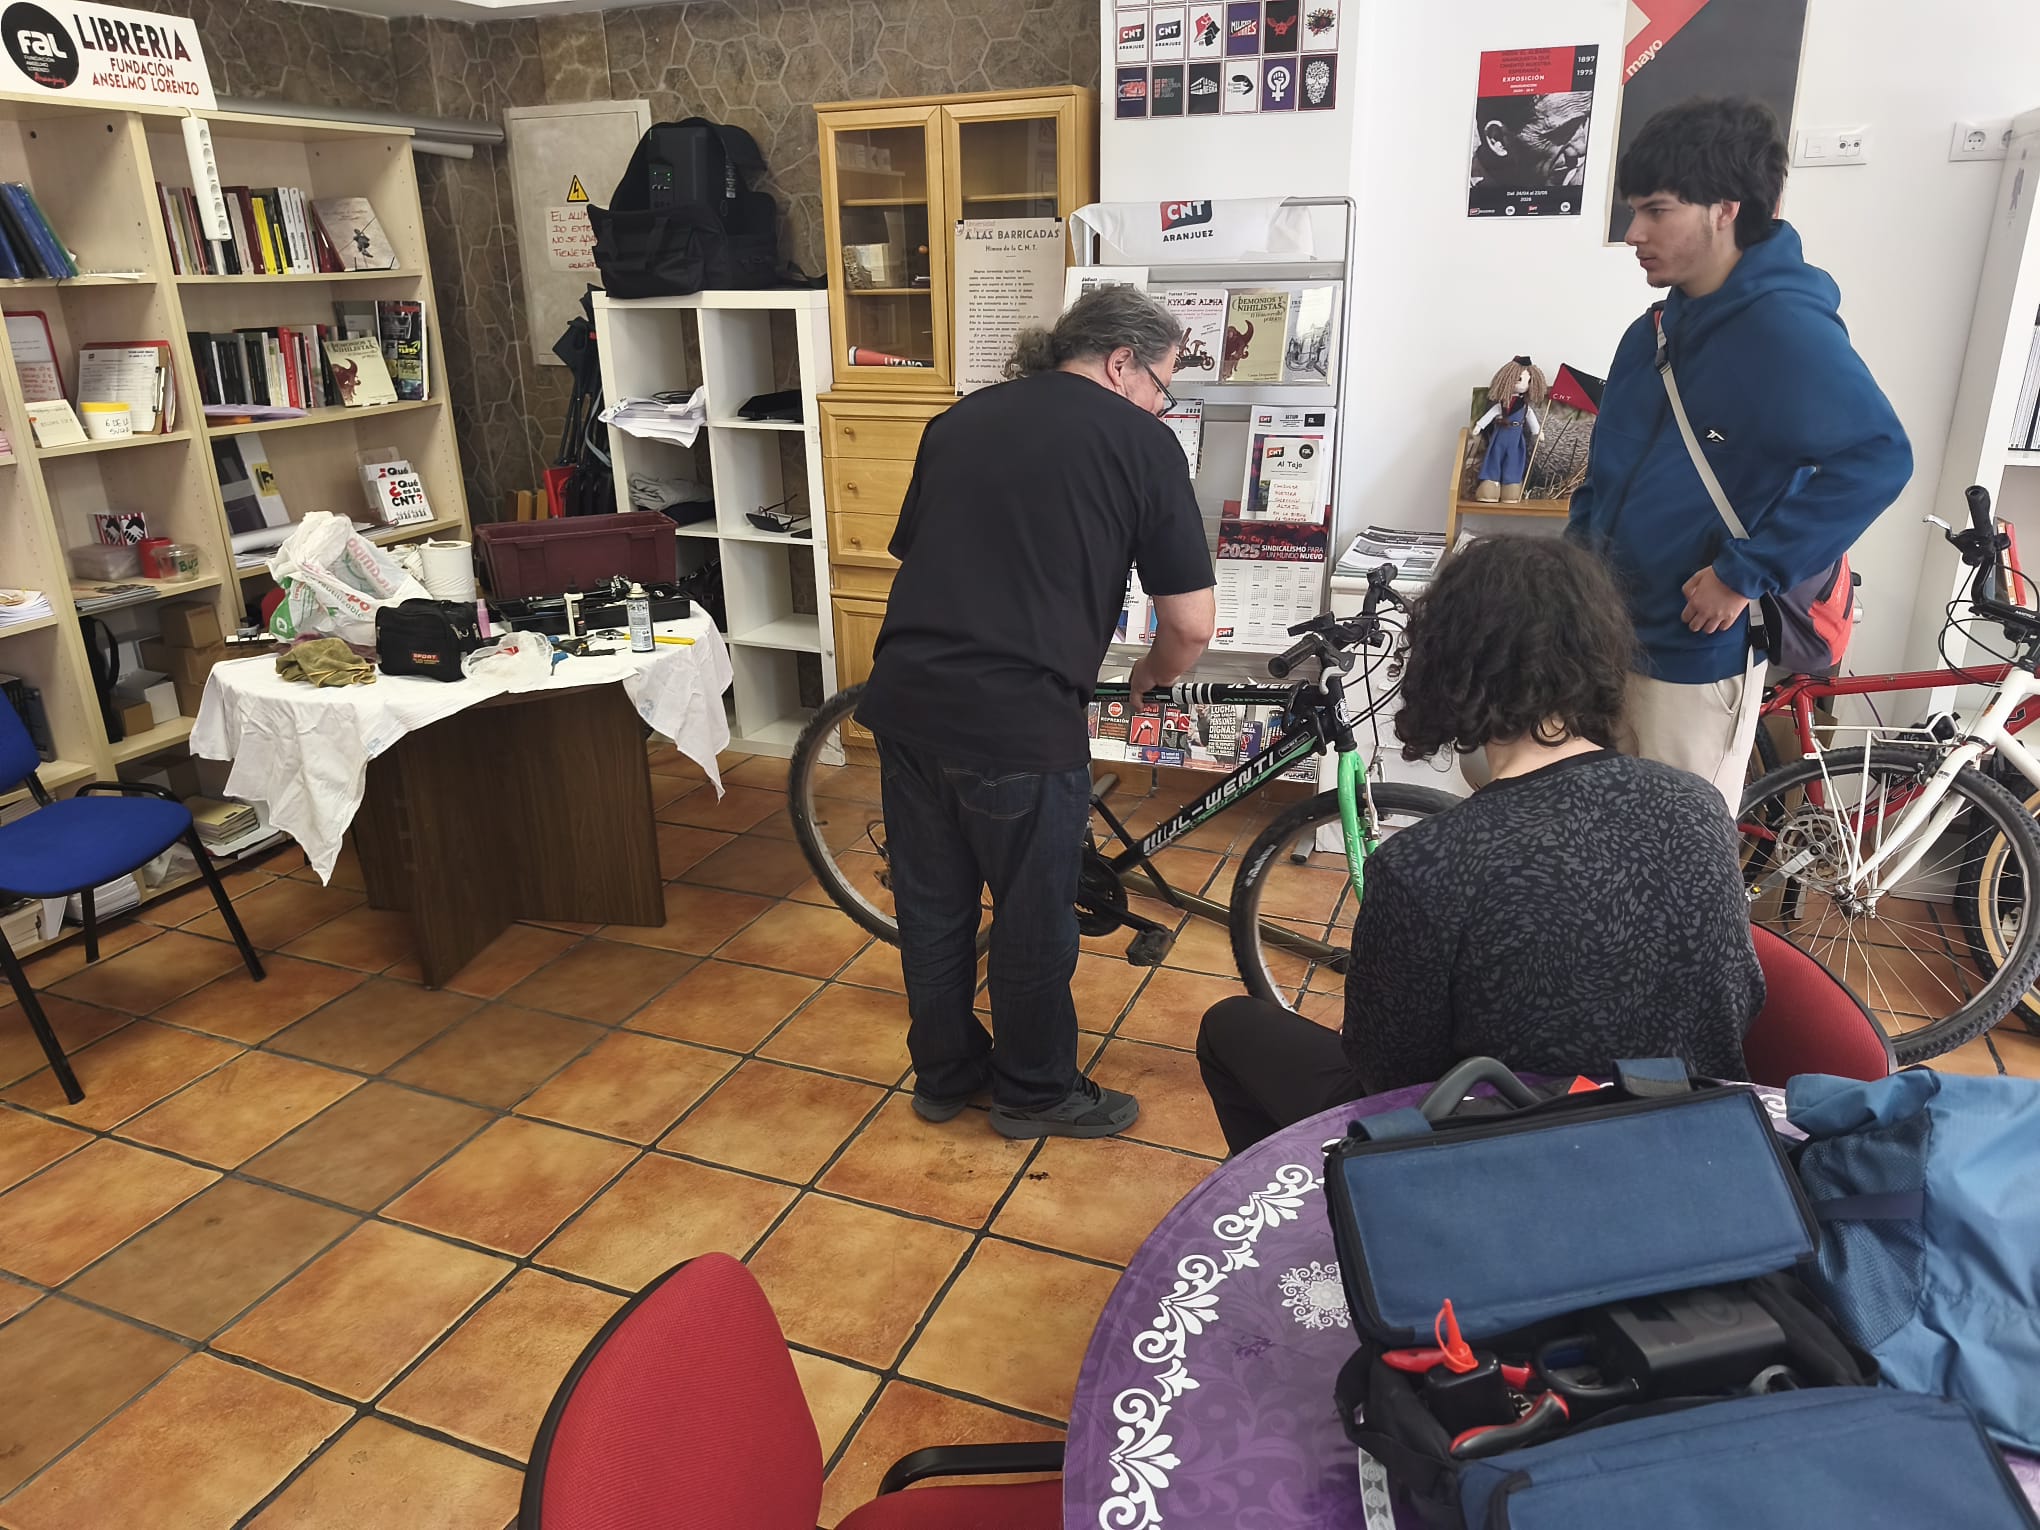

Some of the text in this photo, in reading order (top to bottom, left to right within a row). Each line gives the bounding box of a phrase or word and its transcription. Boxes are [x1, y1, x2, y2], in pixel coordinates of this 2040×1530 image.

[1122, 29, 1142, 38] CNT
[1158, 25, 1178, 36] CNT
[73, 14, 192, 62] LIBRERIA
[1626, 39, 1663, 77] mayo
[1502, 74, 1545, 82] EXPOSICIÓN
[92, 72, 199, 96] ANSELMO LORENZO
[1166, 200, 1205, 220] CNT
[551, 211, 567, 222] EL
[965, 231, 972, 240] A
[976, 230, 993, 240] LAS
[998, 228, 1060, 239] BARRICADAS
[1163, 230, 1214, 242] ARANJUEZ
[1199, 298, 1223, 306] ALPHA
[1239, 296, 1276, 306] DEMONIOS
[1237, 303, 1282, 312] NIHILISTAS
[1552, 393, 1571, 401] CNT
[1287, 461, 1303, 470] Tajo
[413, 485, 421, 494] la
[1219, 543, 1261, 559] 2025
[1261, 544, 1307, 553] SINDICALISMO
[1217, 629, 1232, 638] CNT
[1211, 705, 1236, 714] LUCHA
[1210, 718, 1236, 726] PENSIONES
[1209, 726, 1236, 734] DIGNAS
